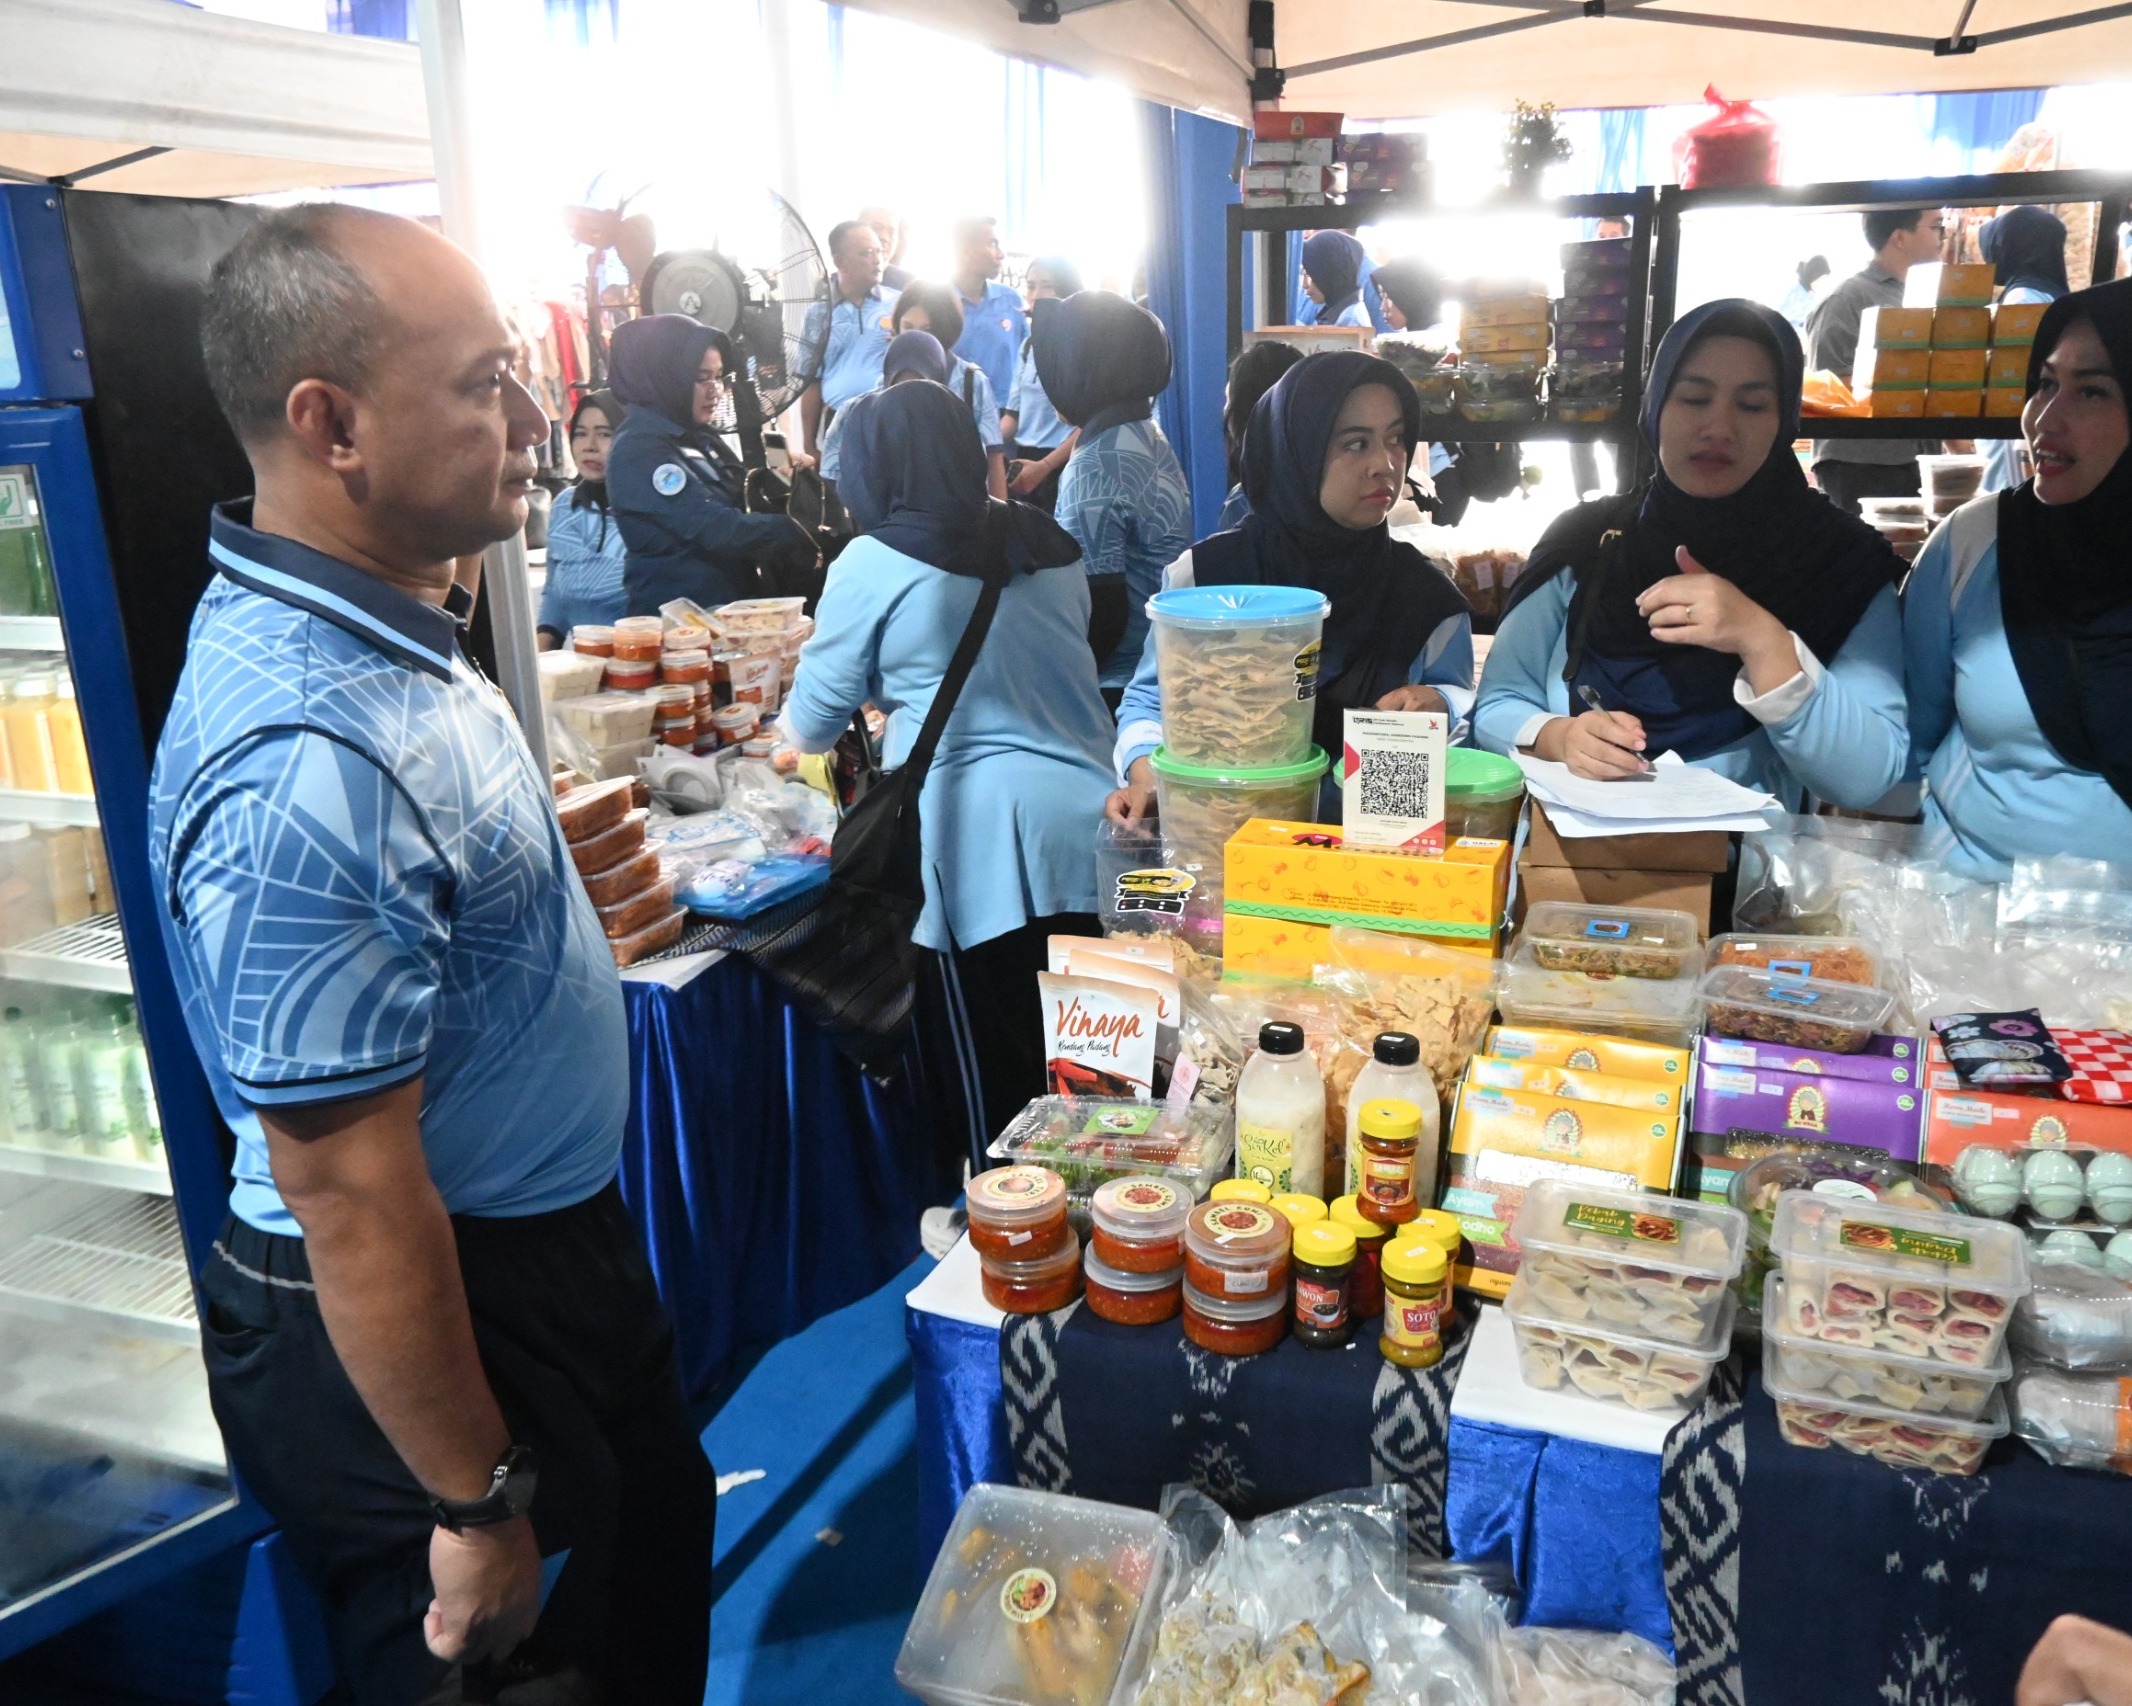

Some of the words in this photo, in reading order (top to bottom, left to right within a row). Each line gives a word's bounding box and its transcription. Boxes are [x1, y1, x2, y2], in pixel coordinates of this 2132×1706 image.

[1057, 996, 1144, 1057] Vinaya
[1446, 1194, 1485, 1211] Ayam
[1578, 1204, 1619, 1217] Kebab
